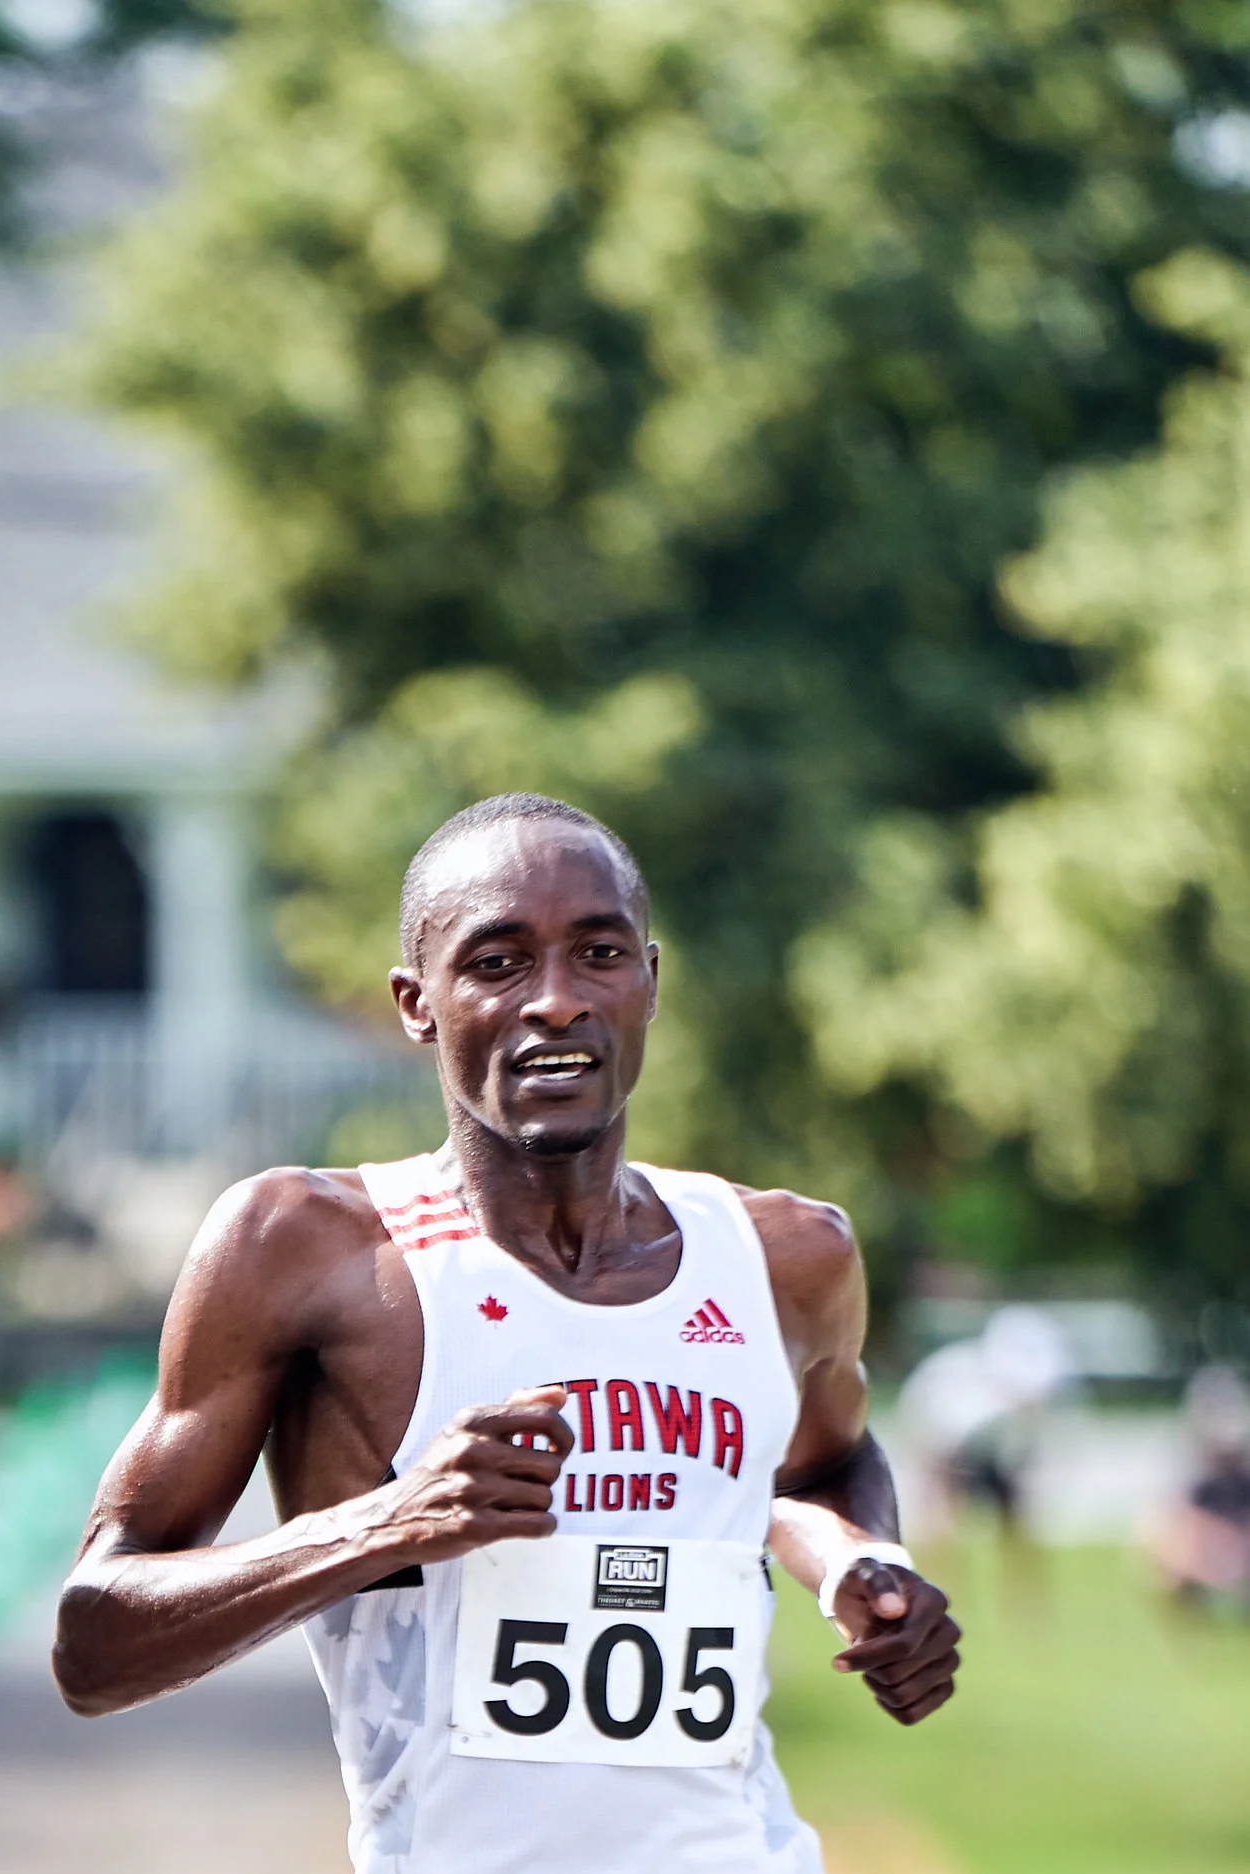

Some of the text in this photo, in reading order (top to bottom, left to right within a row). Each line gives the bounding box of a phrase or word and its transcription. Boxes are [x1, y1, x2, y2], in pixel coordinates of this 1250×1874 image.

[679, 1327, 745, 1344] adidas
[522, 1378, 744, 1480] TAWA
[564, 1472, 677, 1512] LIONS
[607, 1560, 656, 1580] RUN
[483, 1618, 735, 1742] 505
